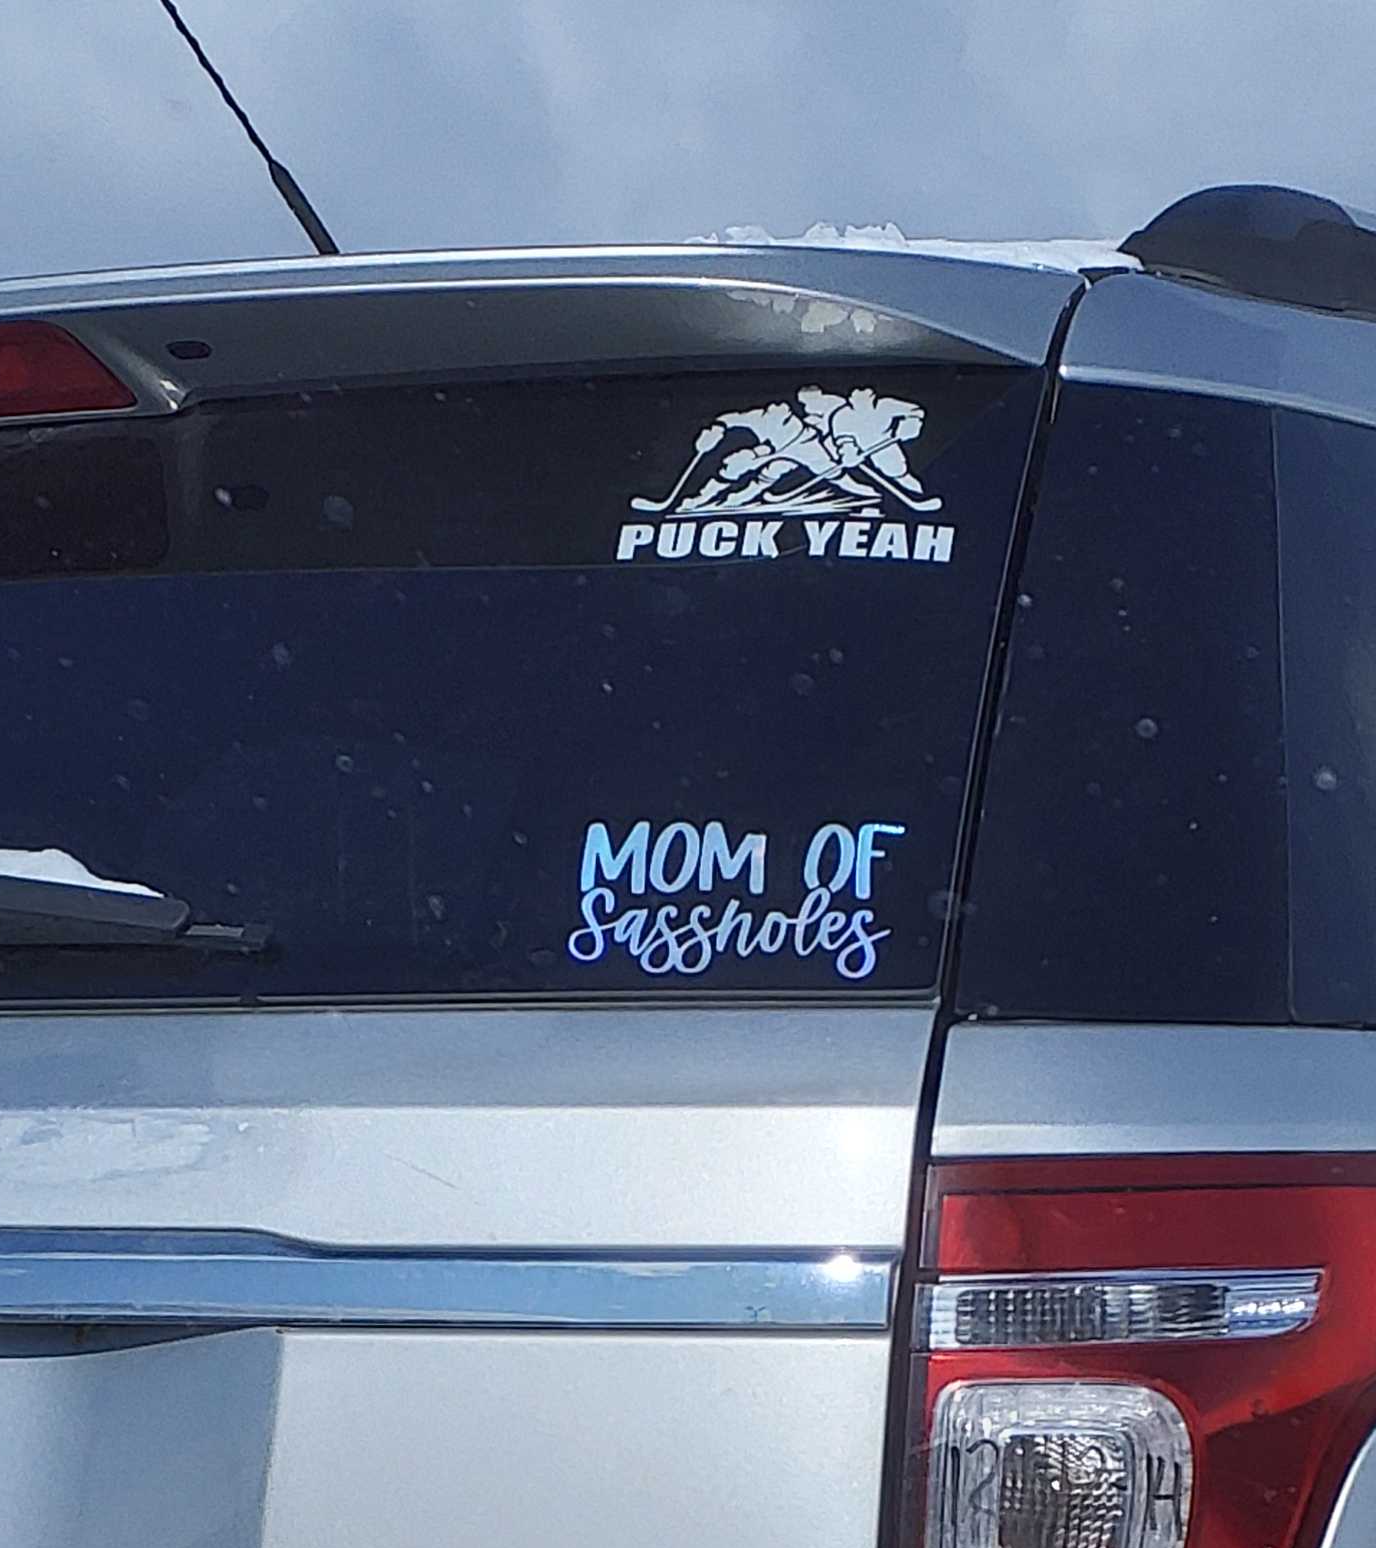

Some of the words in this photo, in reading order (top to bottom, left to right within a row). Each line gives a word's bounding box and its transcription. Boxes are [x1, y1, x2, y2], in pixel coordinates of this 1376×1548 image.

[617, 521, 780, 560] PUCK
[804, 522, 955, 562] YEAH
[580, 821, 767, 895] MOM
[803, 823, 905, 900] OF
[568, 886, 892, 979] Sassholes
